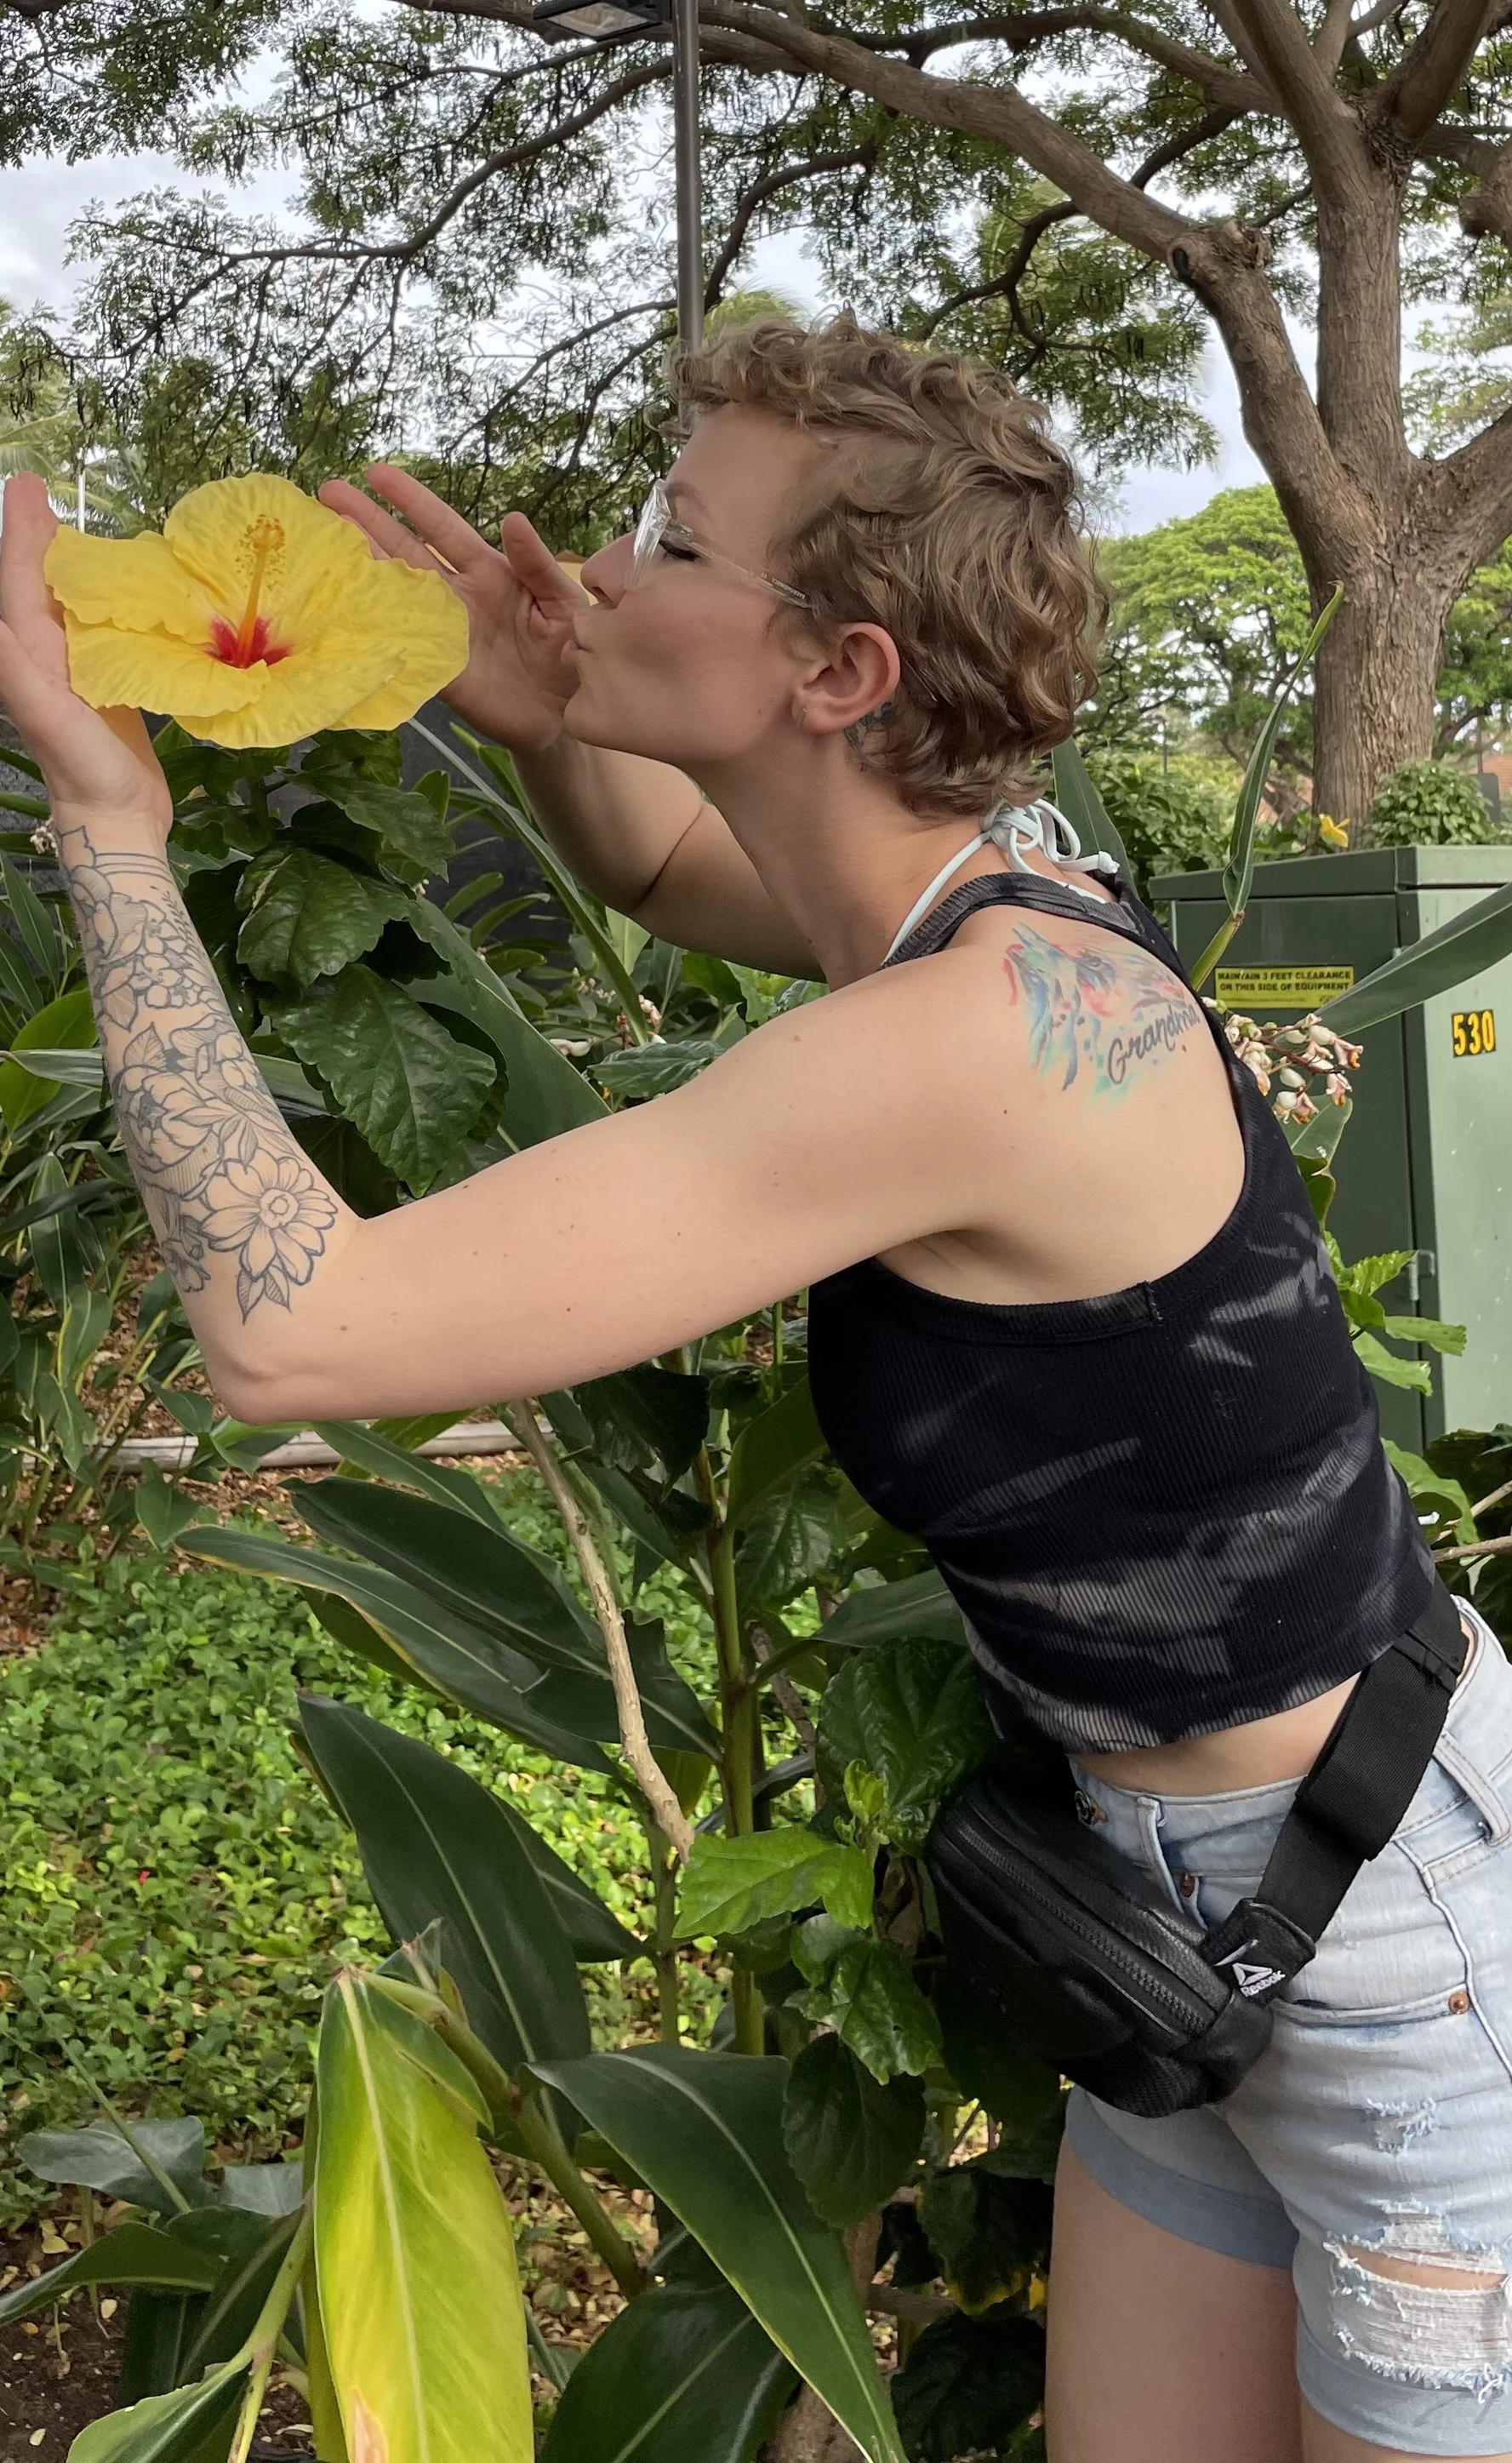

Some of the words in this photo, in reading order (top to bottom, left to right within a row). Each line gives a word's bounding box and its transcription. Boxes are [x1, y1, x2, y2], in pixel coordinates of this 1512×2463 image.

[1218, 972, 1260, 980] MAINTAIN
[1295, 971, 1351, 980] CLEARANCE
[1219, 983, 1232, 991] ON
[1235, 983, 1256, 991] THIS
[1258, 982, 1278, 991] SIDE
[1280, 982, 1291, 991] OF
[1295, 981, 1349, 991] EQUIPMENT
[1452, 1010, 1494, 1056] 530
[1240, 1970, 1286, 1997] Reebok
